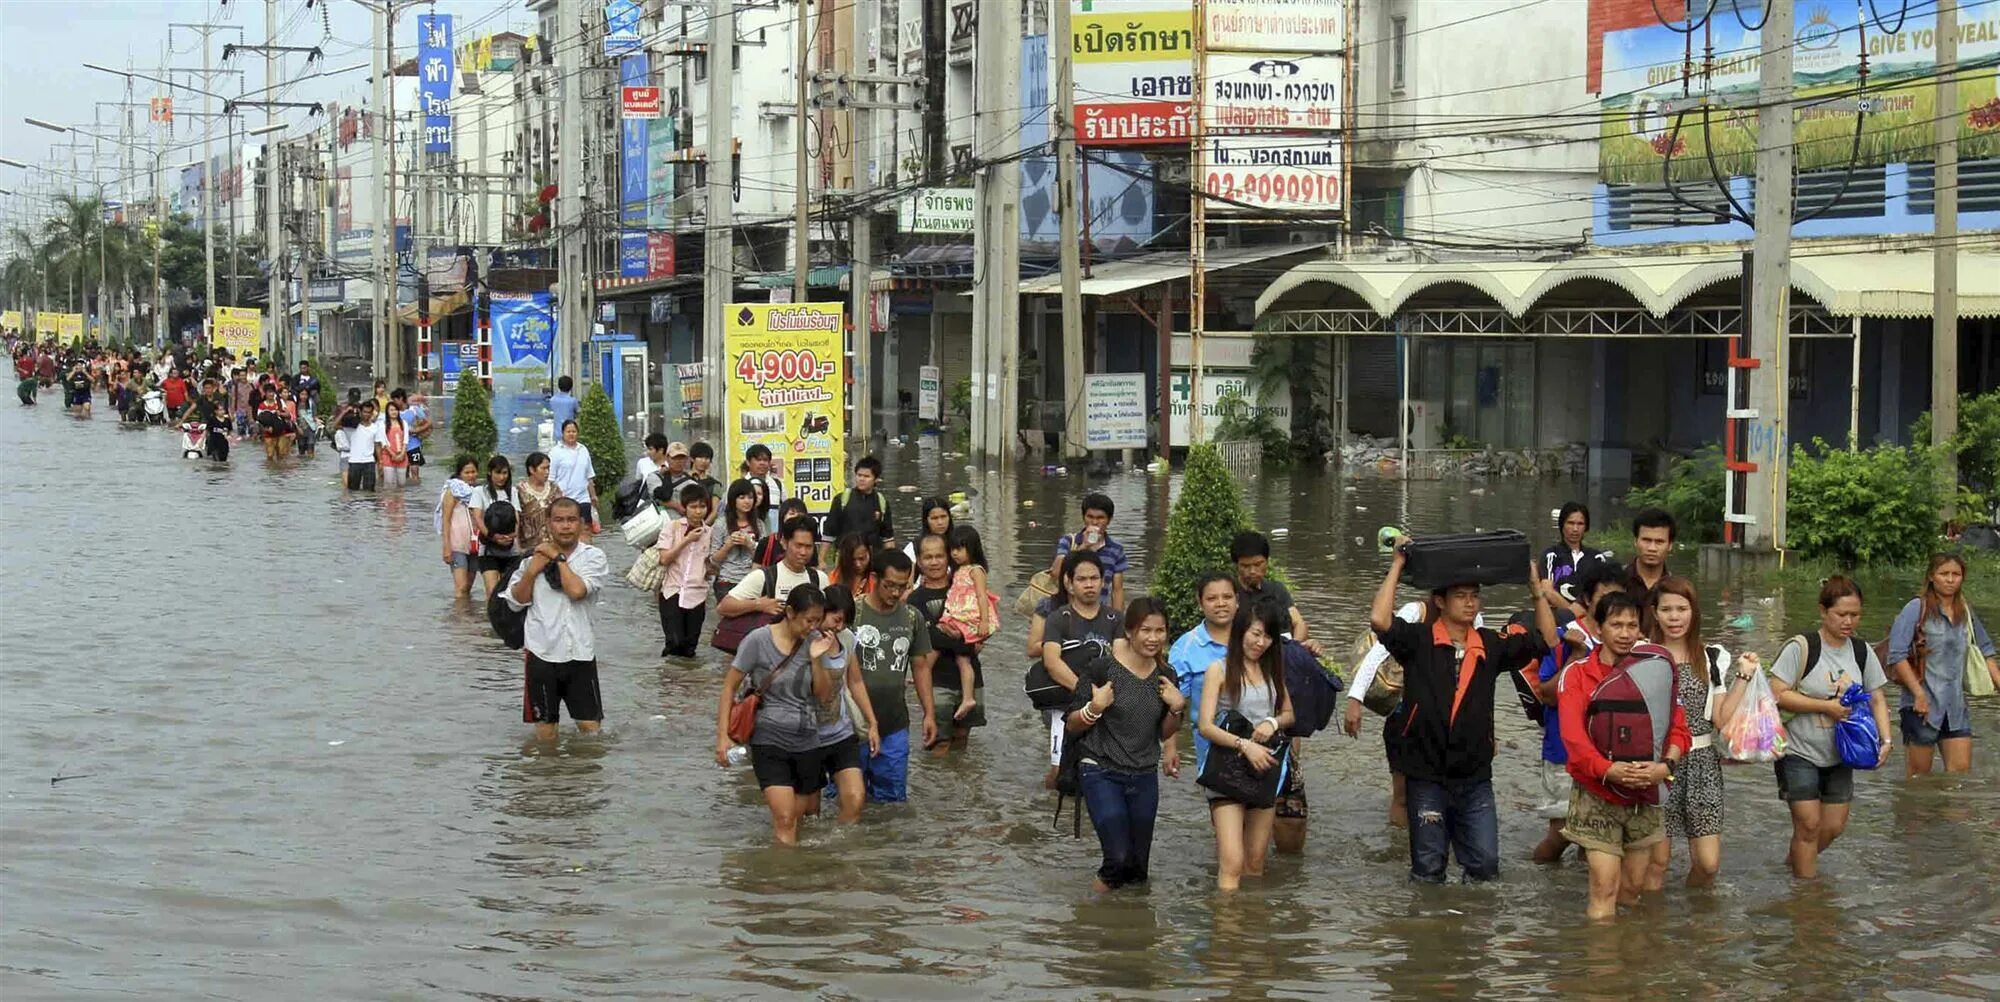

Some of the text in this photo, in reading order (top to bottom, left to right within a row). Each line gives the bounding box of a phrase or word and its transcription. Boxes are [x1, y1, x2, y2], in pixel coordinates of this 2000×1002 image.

[1073, 21, 1192, 53] เปิดรักษา
[1869, 31, 1906, 56] GIVE
[425, 57, 448, 82] ฟ้า
[1647, 65, 1677, 85] GIVE
[737, 350, 834, 389] 4,900.-
[795, 485, 831, 501] iPad
